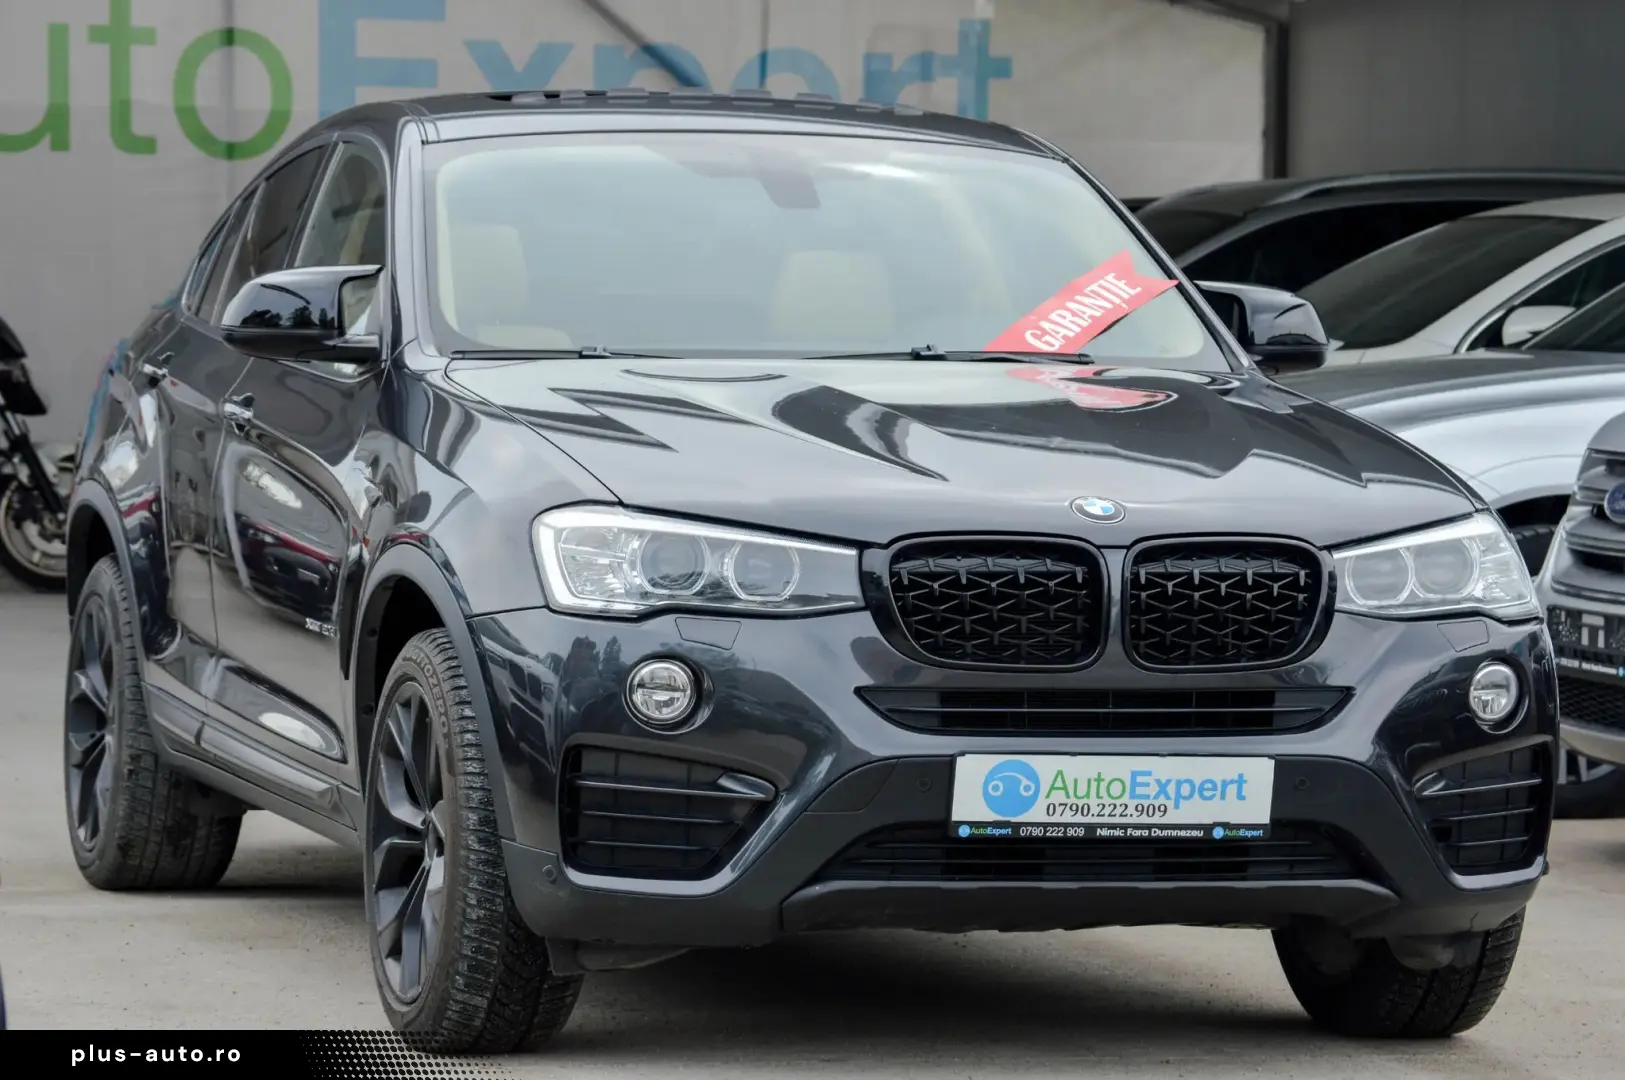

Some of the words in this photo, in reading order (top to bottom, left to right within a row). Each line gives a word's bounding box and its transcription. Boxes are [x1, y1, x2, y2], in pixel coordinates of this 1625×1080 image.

[1045, 768, 1248, 810] AutoExpert
[1045, 802, 1168, 818] 0790.222.909
[970, 826, 1012, 836] AutoExpert
[1019, 826, 1044, 836] 0790
[1046, 827, 1064, 836] 222
[1066, 827, 1085, 837] 909
[1096, 827, 1125, 837] Nimic
[1127, 828, 1149, 837] Fara
[1151, 828, 1204, 838] Dumnezeu
[1224, 829, 1264, 838] AutoExpert
